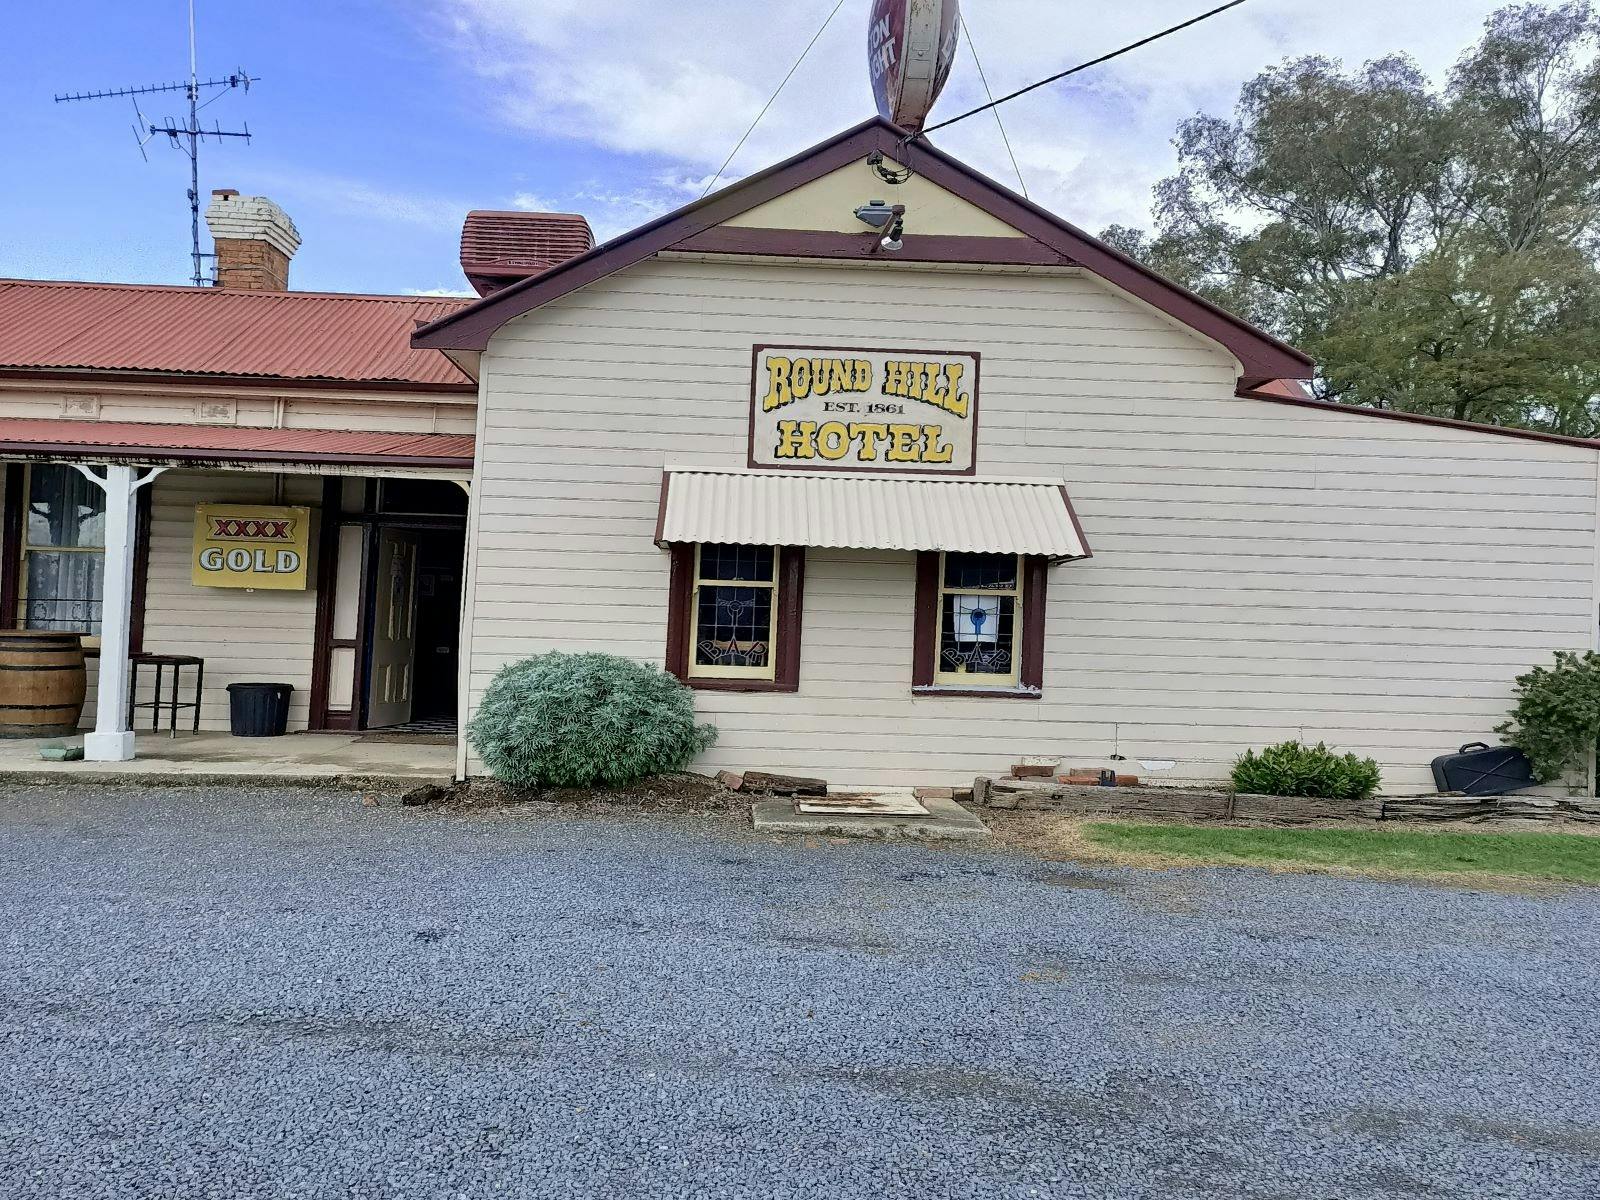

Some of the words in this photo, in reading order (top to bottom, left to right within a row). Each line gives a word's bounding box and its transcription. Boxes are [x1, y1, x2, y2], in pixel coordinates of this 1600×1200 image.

[763, 356, 873, 412] ROUND
[881, 361, 969, 419] HILL
[822, 401, 860, 413] EST.
[866, 403, 905, 415] 1861
[774, 420, 953, 463] HOTEL
[213, 519, 289, 539] XXXX
[199, 547, 300, 573] GOLD
[698, 635, 768, 662] BAR
[942, 641, 1011, 668] BAR
